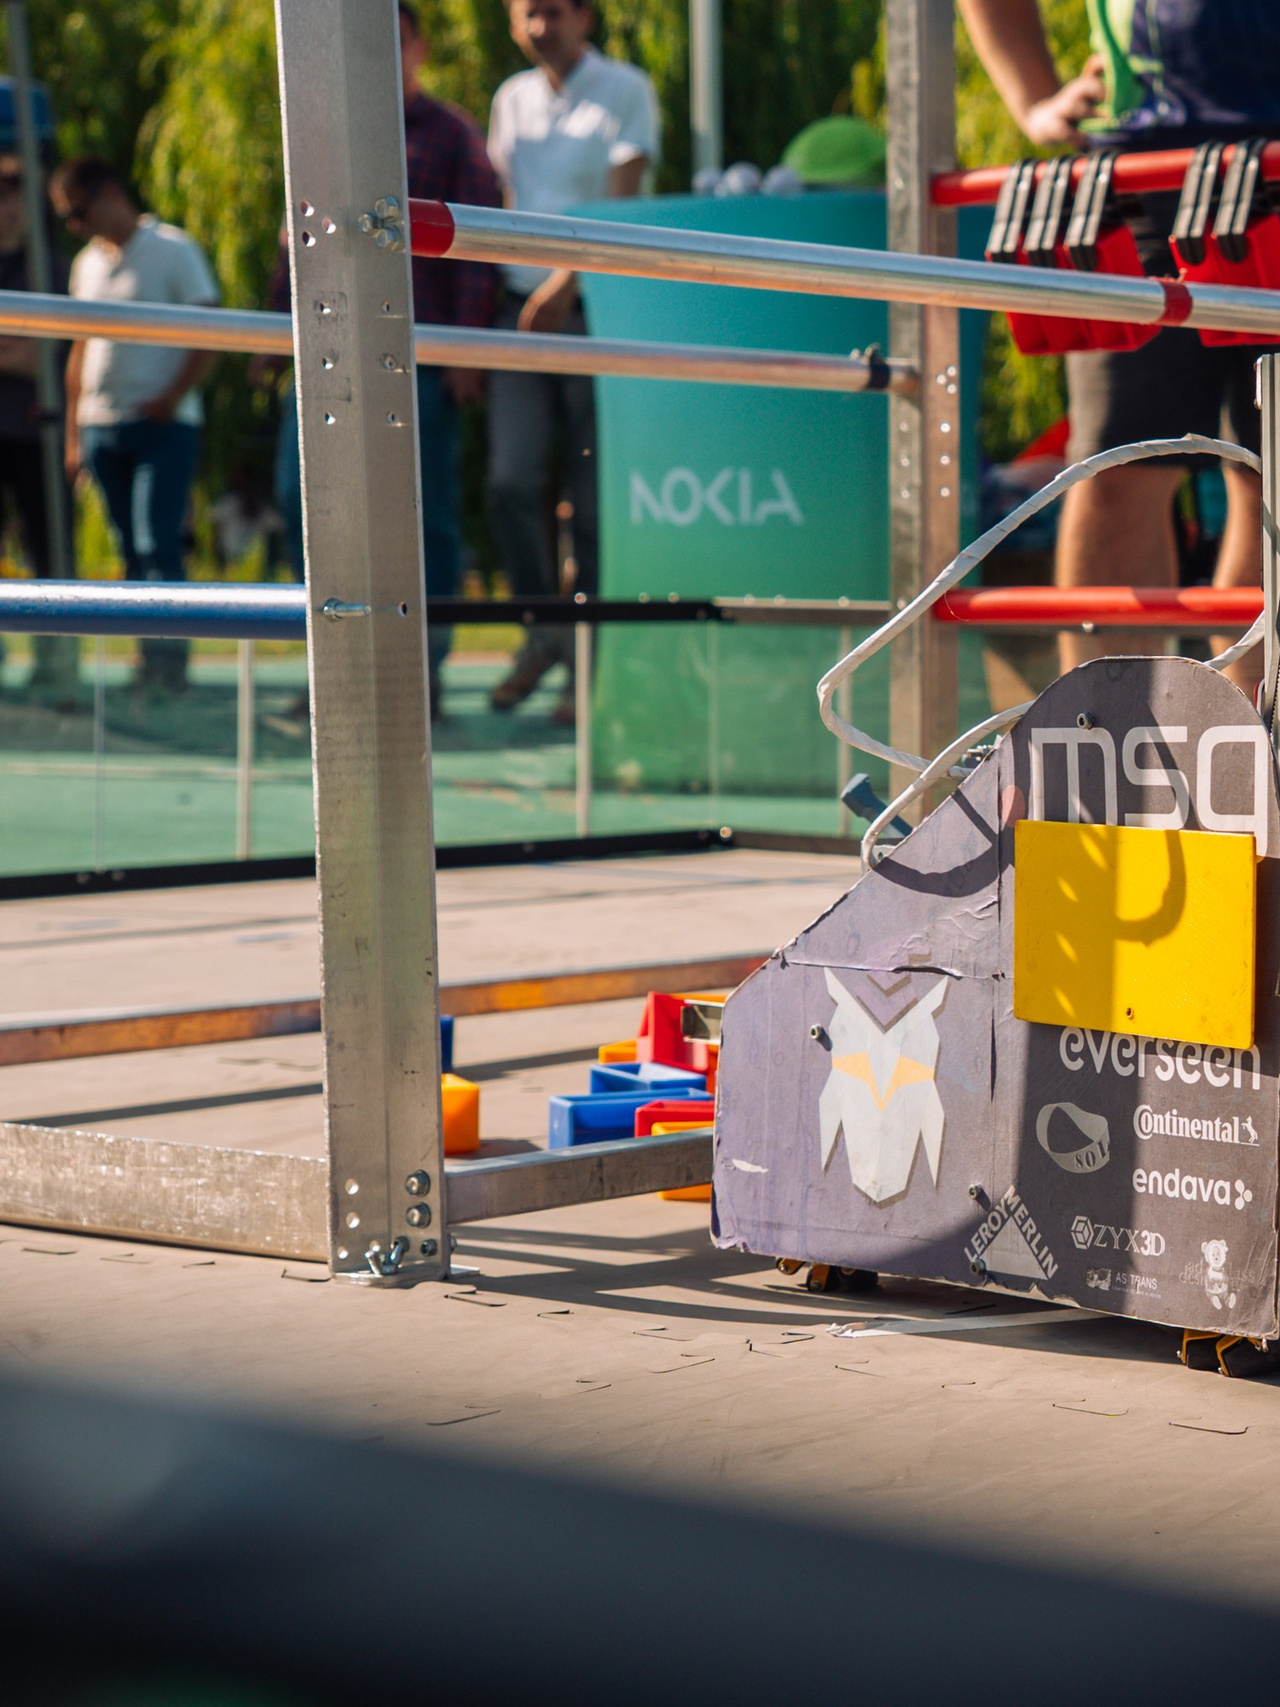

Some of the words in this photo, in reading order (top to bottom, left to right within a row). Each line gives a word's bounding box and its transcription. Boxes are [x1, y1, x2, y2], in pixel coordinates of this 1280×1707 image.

[629, 467, 804, 527] NOKIA
[1059, 1025, 1261, 1091] everseen
[1133, 1104, 1240, 1144] Continental
[1132, 1168, 1231, 1206] endava
[963, 1197, 1009, 1264] LEROY
[1003, 1185, 1059, 1279] MERLIN
[1093, 1224, 1166, 1257] ZYX3D
[1115, 1271, 1128, 1285] AS
[1129, 1274, 1158, 1290] TRANS
